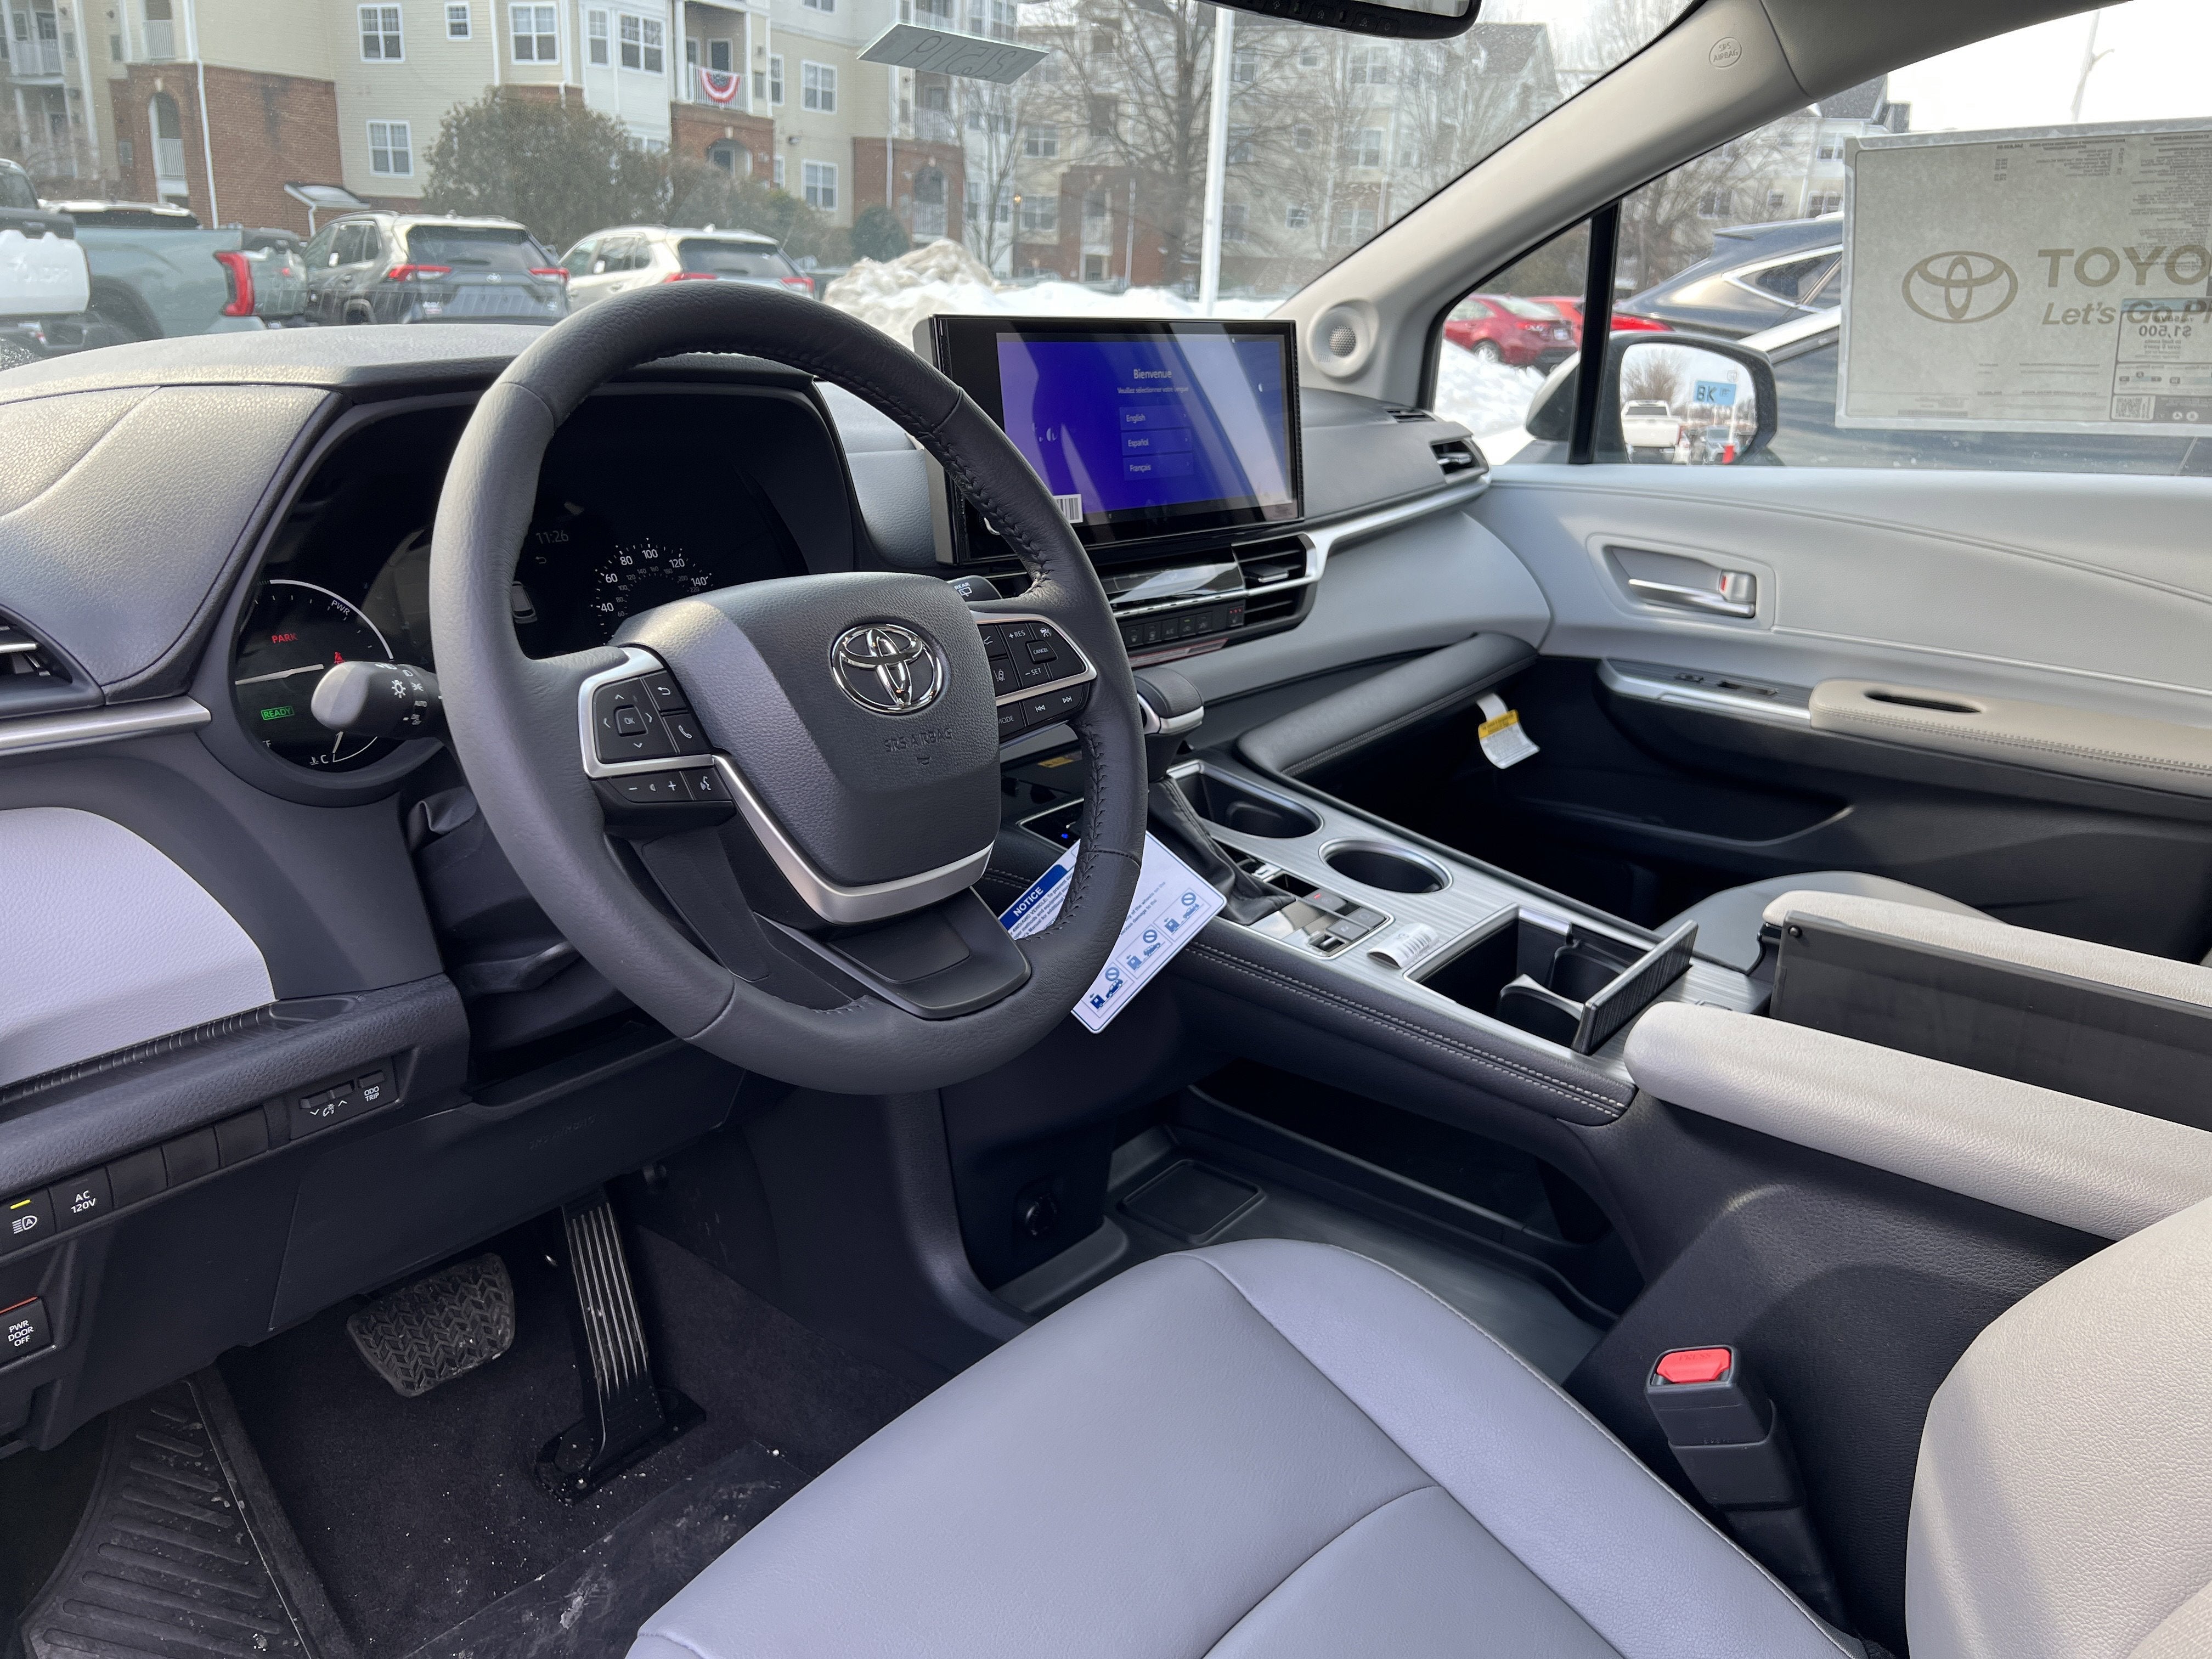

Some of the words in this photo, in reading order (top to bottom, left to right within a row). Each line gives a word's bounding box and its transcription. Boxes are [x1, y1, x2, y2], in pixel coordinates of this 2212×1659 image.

[1718, 42, 1731, 52] SRS
[1713, 49, 1739, 63] AIRBAG
[2042, 302, 2116, 325] Let's
[2126, 300, 2172, 324] Go
[1133, 369, 1172, 379] Bienvenue
[1126, 414, 1146, 424] English
[1127, 438, 1149, 448] Español
[1130, 464, 1152, 472] Français
[535, 530, 569, 544] 11:26
[641, 549, 658, 559] 100
[619, 556, 633, 566] 80
[669, 558, 685, 568] 120
[605, 573, 618, 583] 60
[690, 576, 707, 587] 140
[954, 582, 970, 590] REAR
[331, 600, 351, 616] PWR
[601, 602, 614, 612] 40
[271, 633, 298, 644] PARK
[263, 707, 292, 718] READY
[884, 737, 906, 752] SRS
[911, 727, 952, 747] AIRBAG
[1053, 880, 1067, 894] prevent
[1013, 887, 1044, 916] NOTICE
[1029, 919, 1041, 932] Manual
[364, 1086, 380, 1096] ODO
[365, 1092, 380, 1102] TRIP
[75, 1190, 91, 1203] AC
[71, 1198, 97, 1213] 120V
[9, 1319, 30, 1333] PWR
[8, 1326, 34, 1342] DOOR
[14, 1335, 31, 1347] OFF
